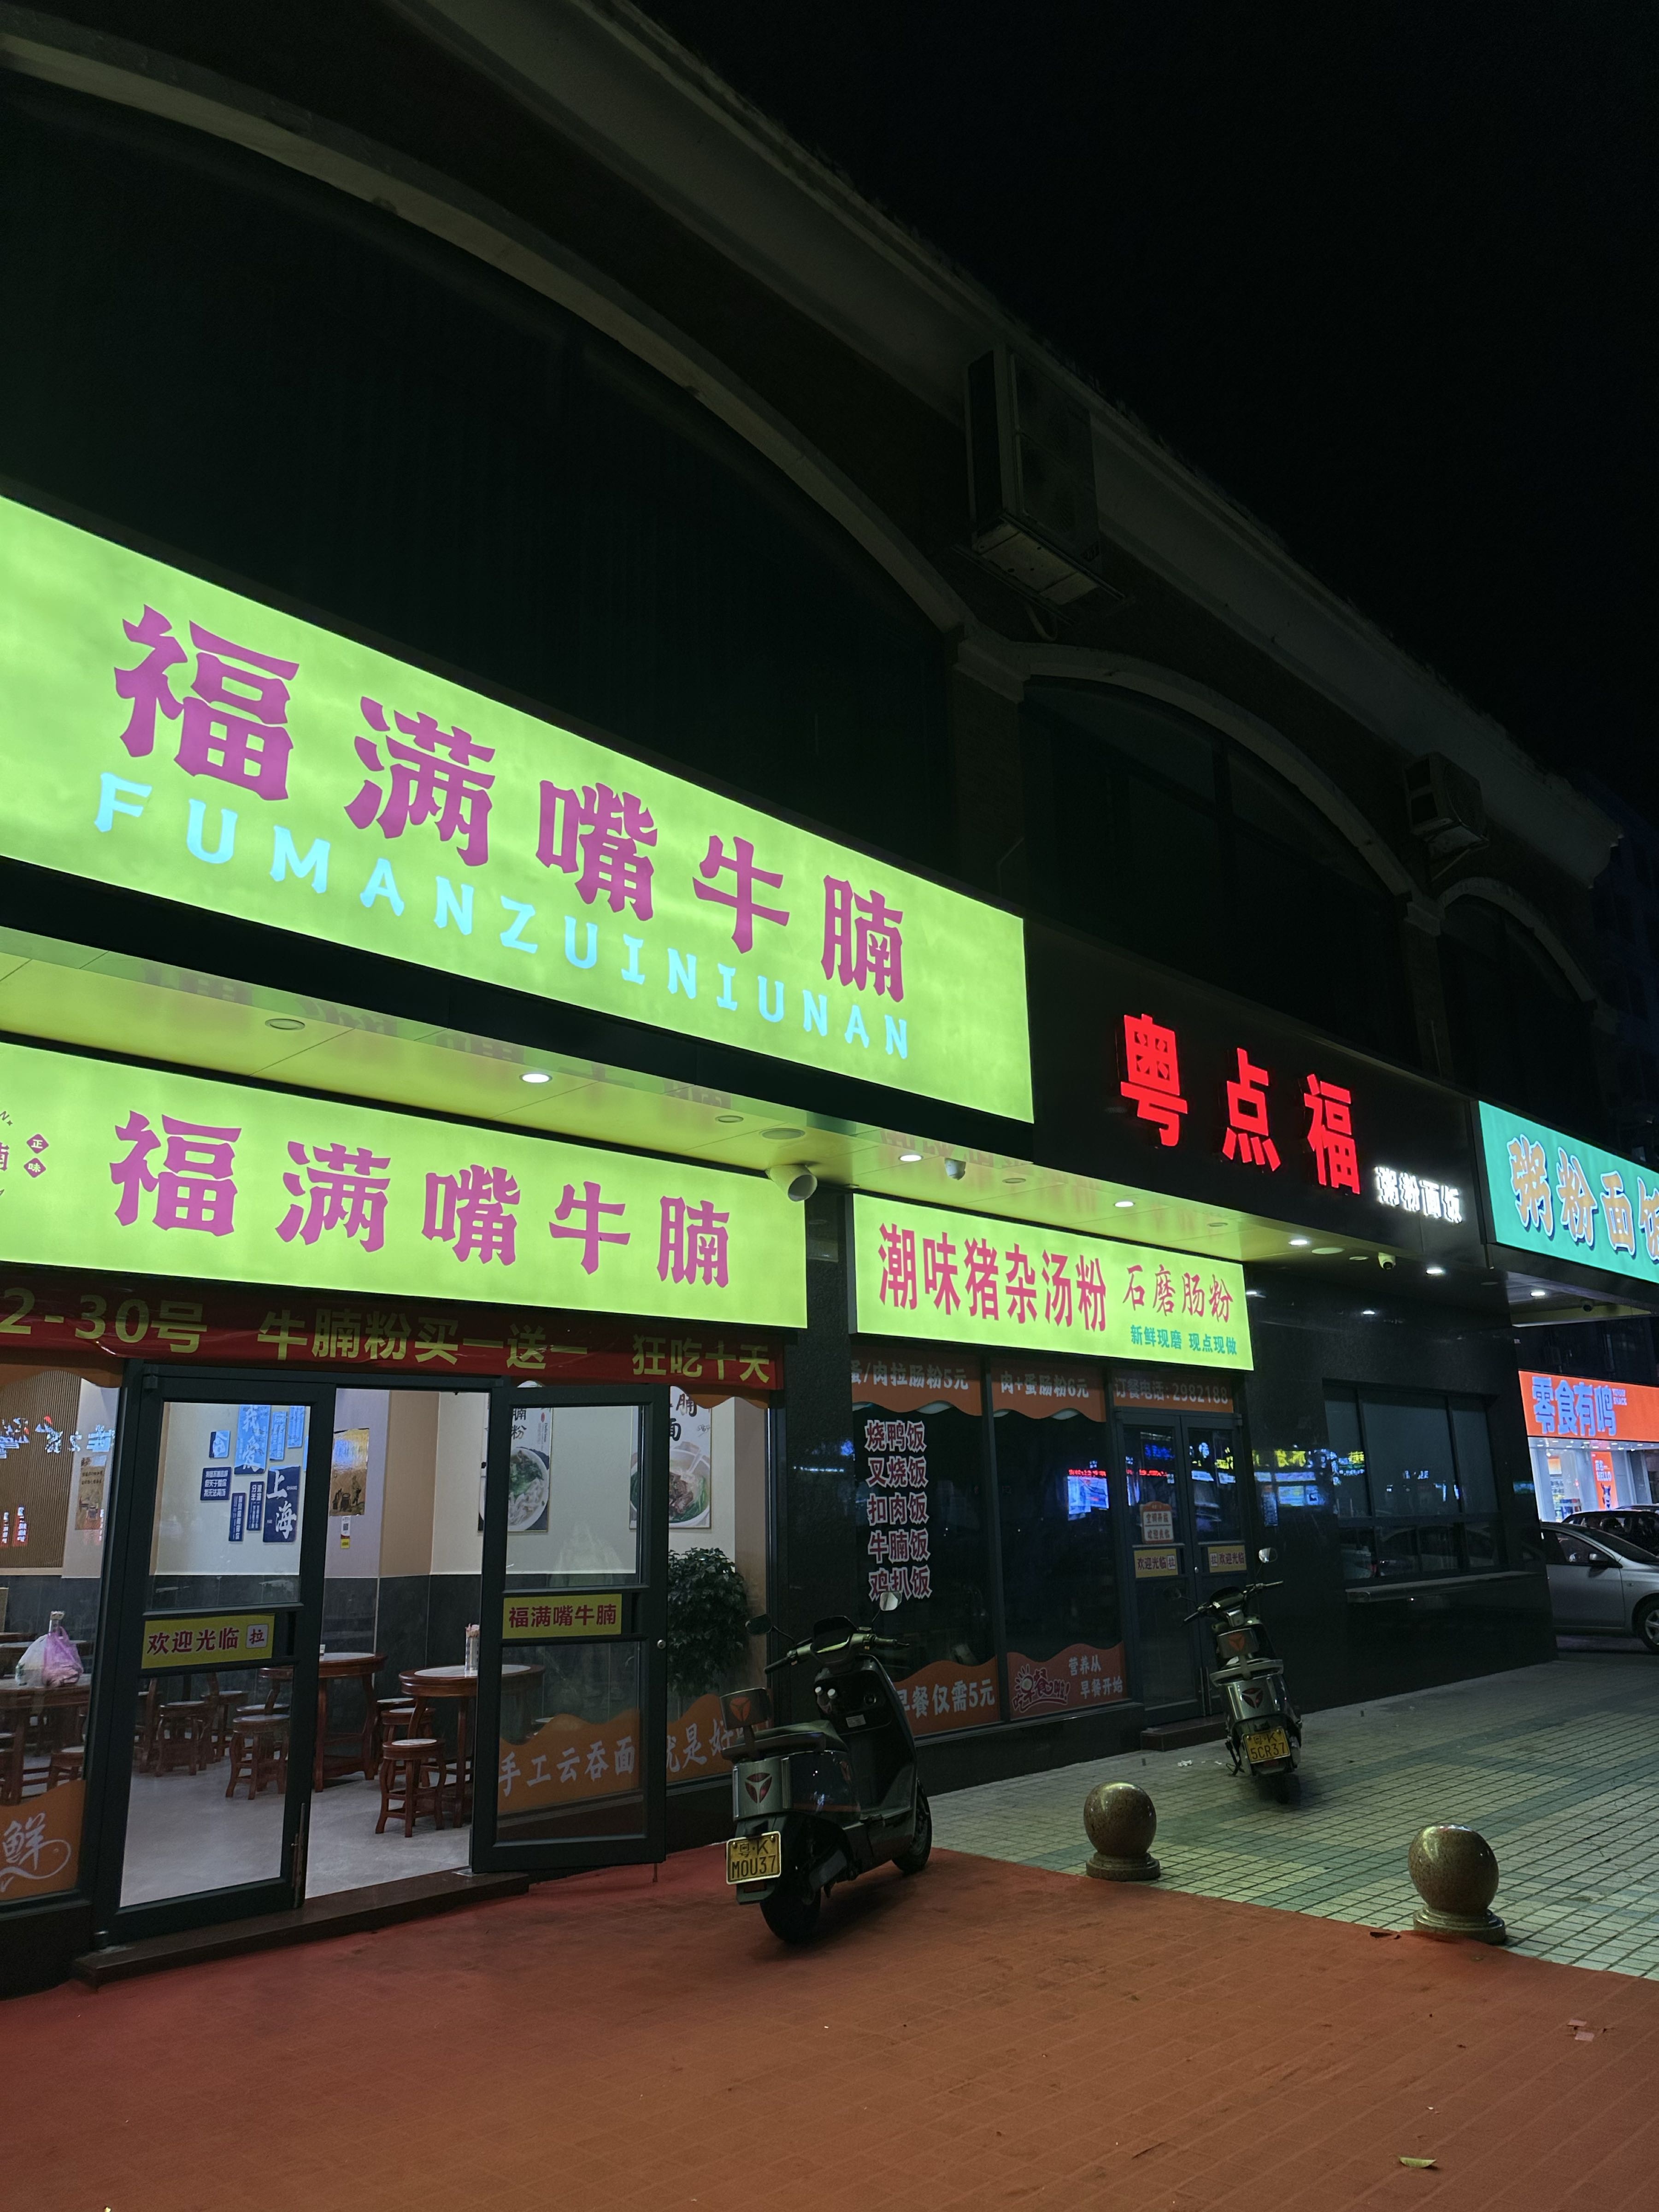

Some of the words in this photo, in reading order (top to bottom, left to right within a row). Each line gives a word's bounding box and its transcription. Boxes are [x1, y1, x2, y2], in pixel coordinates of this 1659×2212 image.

[113, 604, 904, 1003] 福满嘴牛腩
[94, 771, 908, 1059] FUMANZUINIUNAN
[1120, 1013, 1360, 1195] 粤点福
[109, 1110, 730, 1288] 福满嘴牛腩
[878, 1223, 1106, 1332] 潮味猪杂汤粉
[1123, 1264, 1234, 1323] 石磨肠粉
[257, 1308, 588, 1370] 牛腩粉买一送一
[632, 1334, 770, 1383] 狂吃十天
[1131, 1324, 1182, 1349] 新鲜现磨
[1188, 1333, 1237, 1355] 现点现做
[1532, 1376, 1617, 1436] 零食有鸣
[865, 1419, 927, 1453] 烧鸭饭
[865, 1455, 929, 1488] 叉烧饭
[266, 1470, 297, 1539] 上海
[866, 1491, 930, 1526] 扣肉饭
[868, 1527, 931, 1564] 牛腩饭
[508, 1603, 618, 1629] 福满嘴牛腩
[147, 1627, 240, 1655] 欢迎光临
[249, 1628, 265, 1645] 拉
[1068, 1654, 1101, 1677] 营养从
[1079, 1676, 1124, 1700] 早餐开始
[498, 1735, 635, 1796] 手工云吞面
[1250, 1742, 1285, 1760] 5CR37
